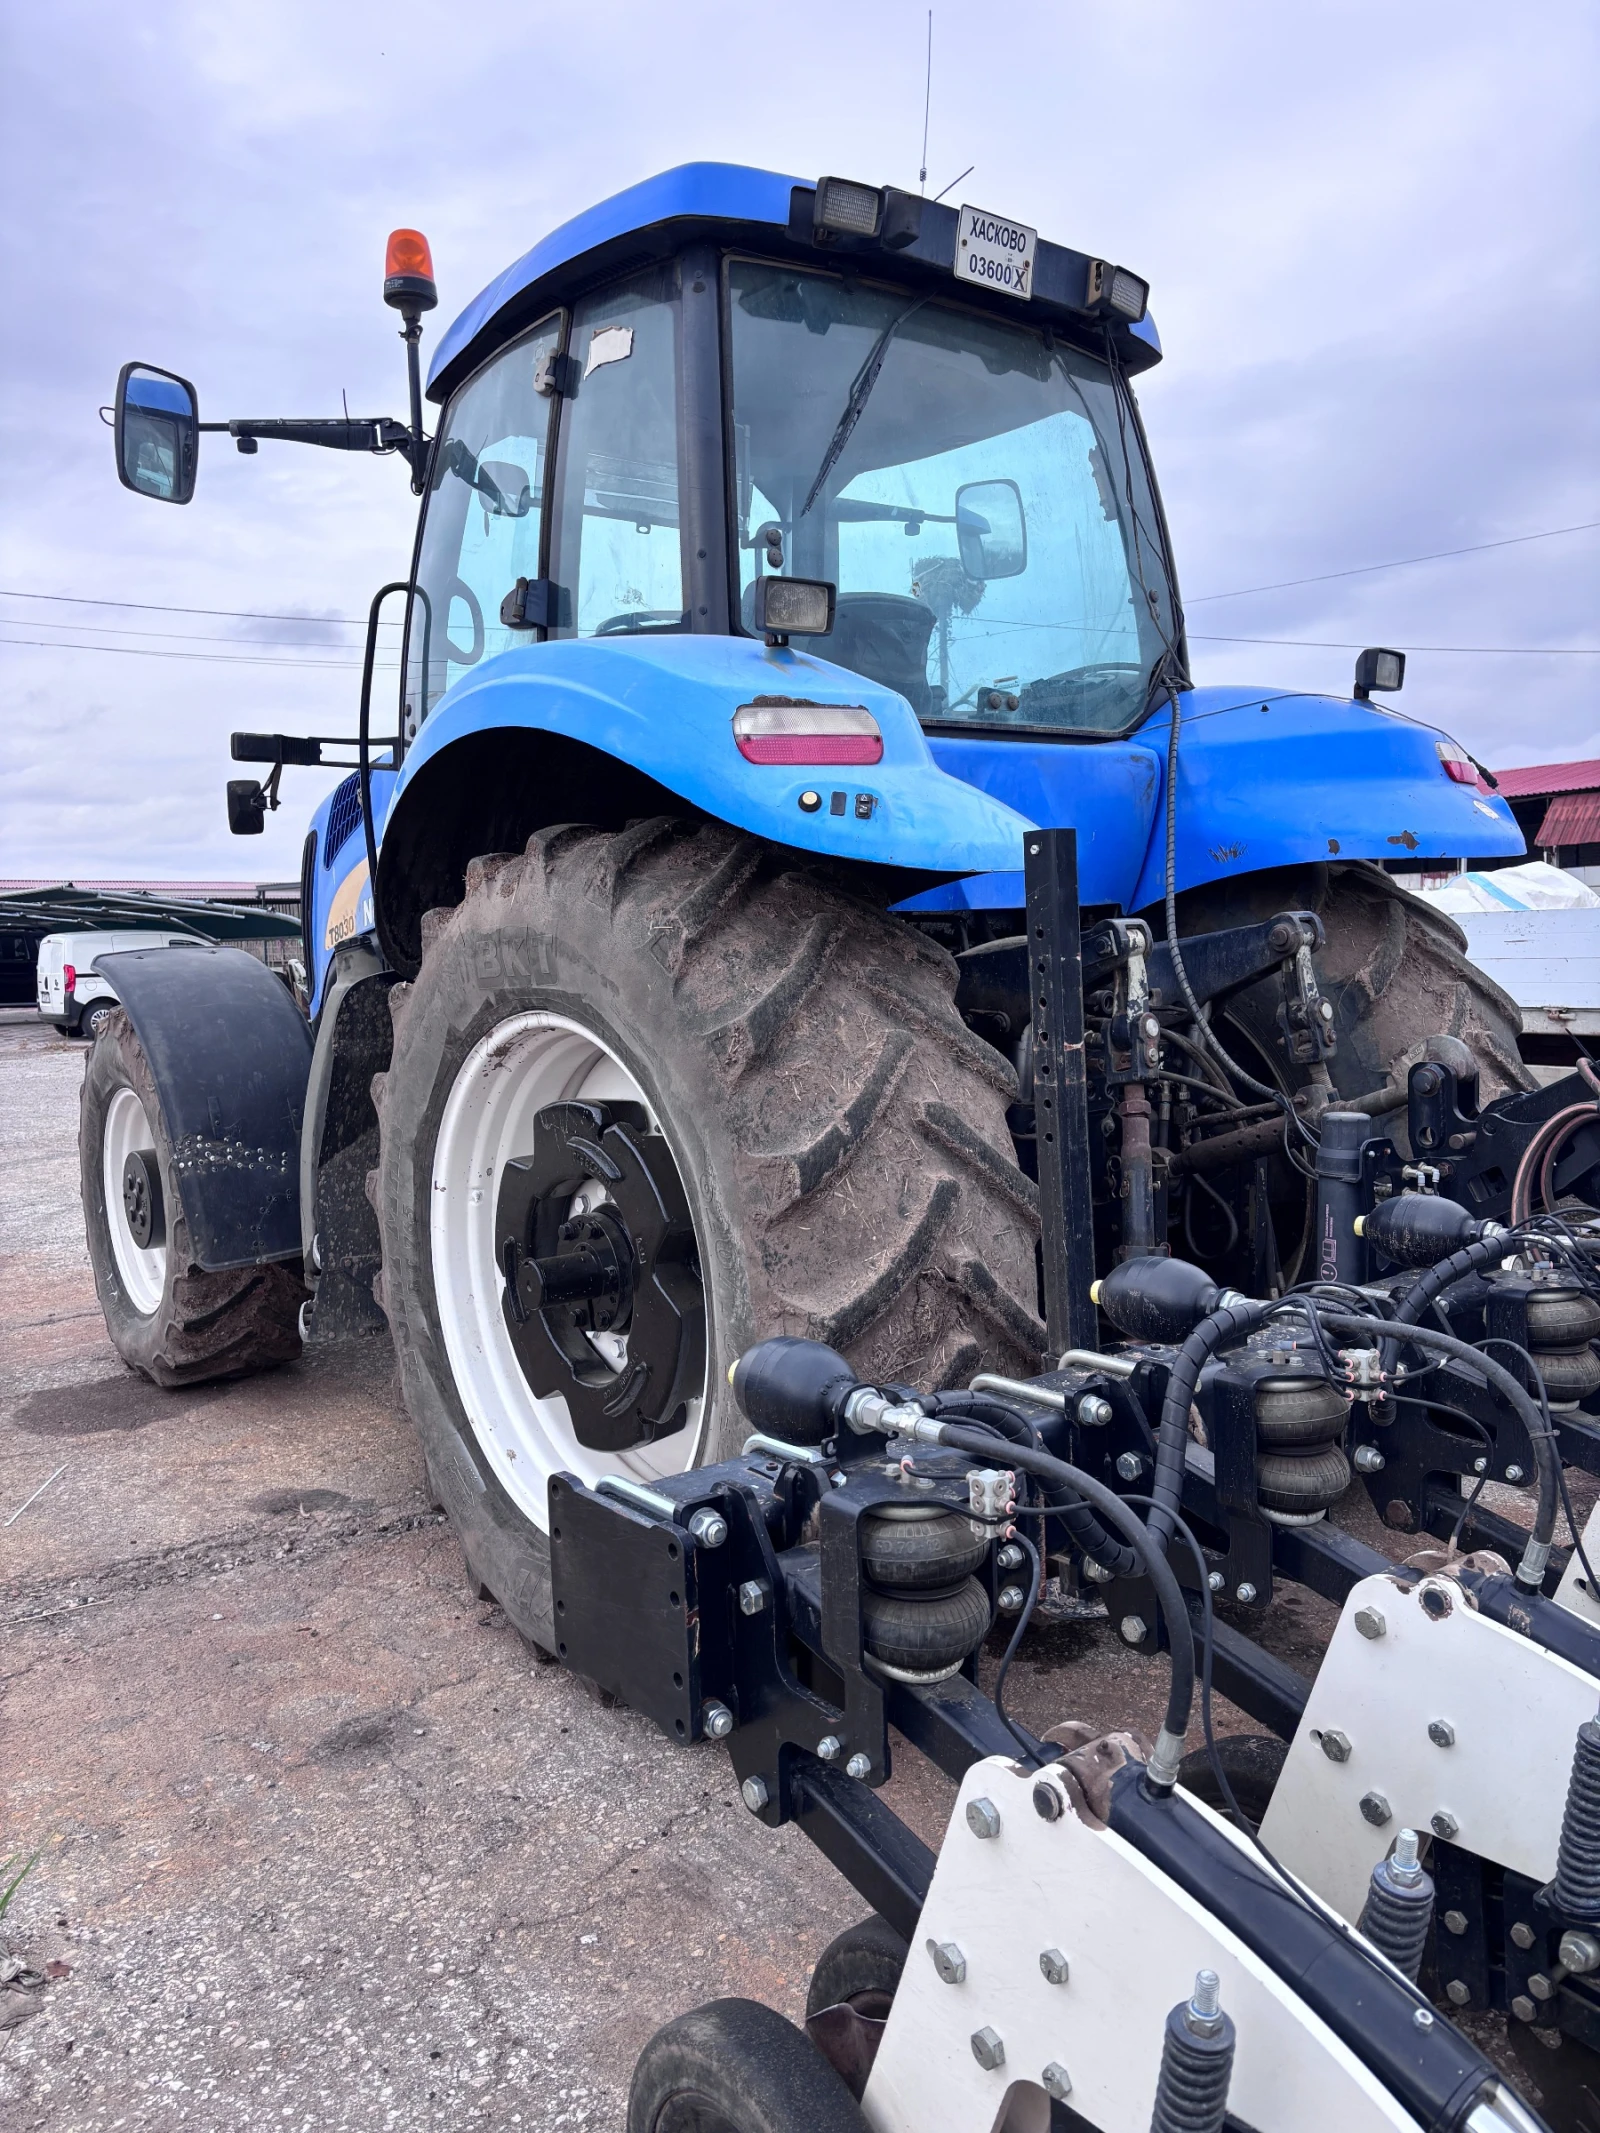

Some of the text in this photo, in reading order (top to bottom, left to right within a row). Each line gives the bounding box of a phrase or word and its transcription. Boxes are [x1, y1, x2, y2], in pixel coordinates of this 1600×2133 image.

[969, 215, 1027, 253] ХАСКОВО
[328, 915, 355, 946] T8030
[475, 933, 555, 980] BKT
